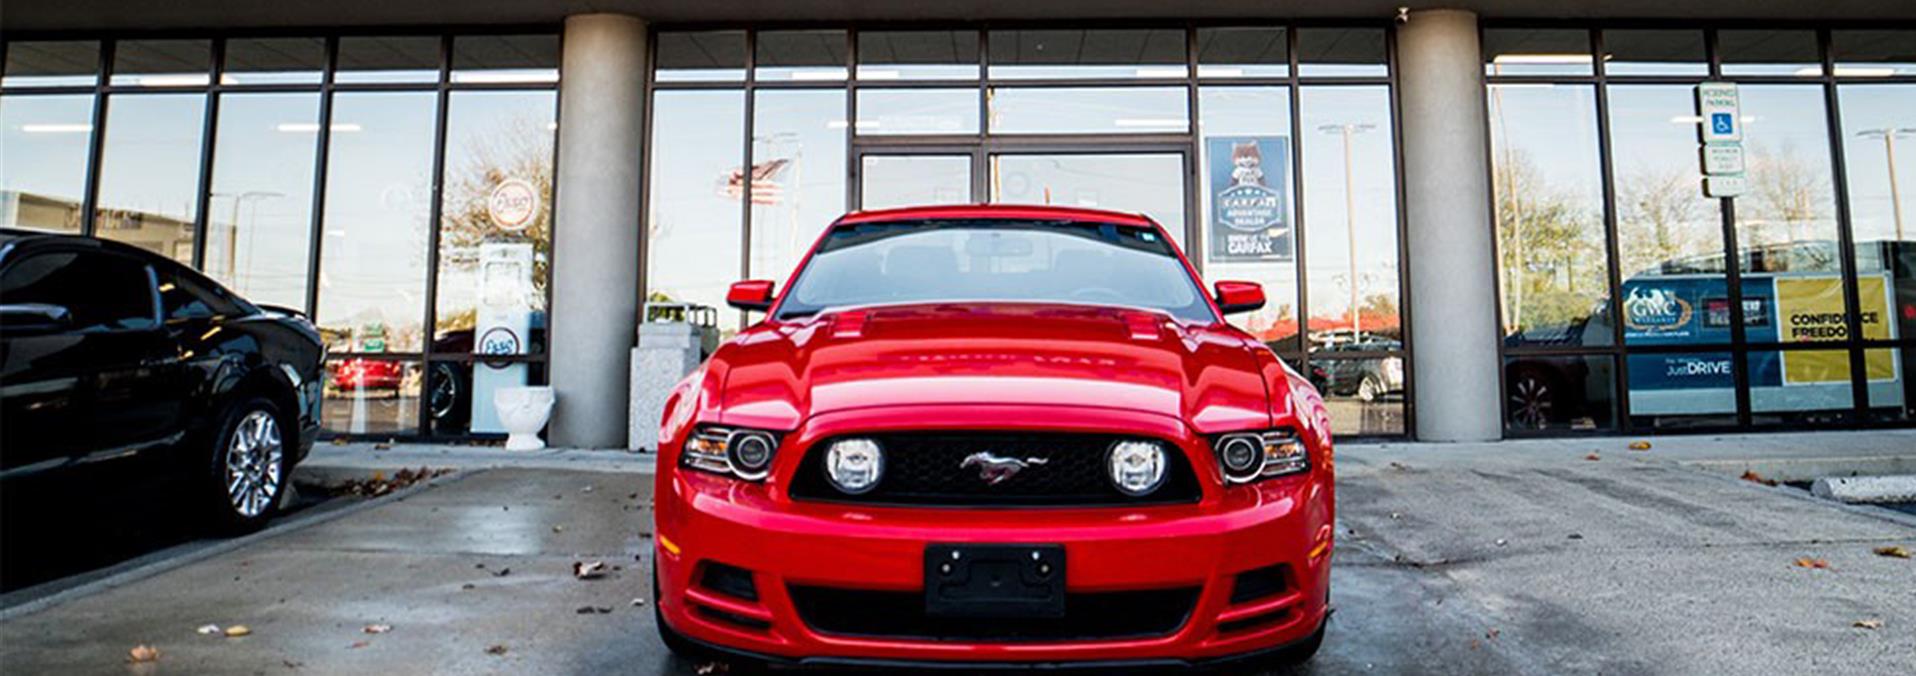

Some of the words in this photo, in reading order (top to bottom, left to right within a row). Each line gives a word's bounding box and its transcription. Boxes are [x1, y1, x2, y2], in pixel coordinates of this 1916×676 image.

[1228, 241, 1272, 254] CARFAX
[1632, 299, 1676, 316] GWC
[1791, 312, 1879, 325] CONFIDCE
[1792, 326, 1848, 337] FREEDO
